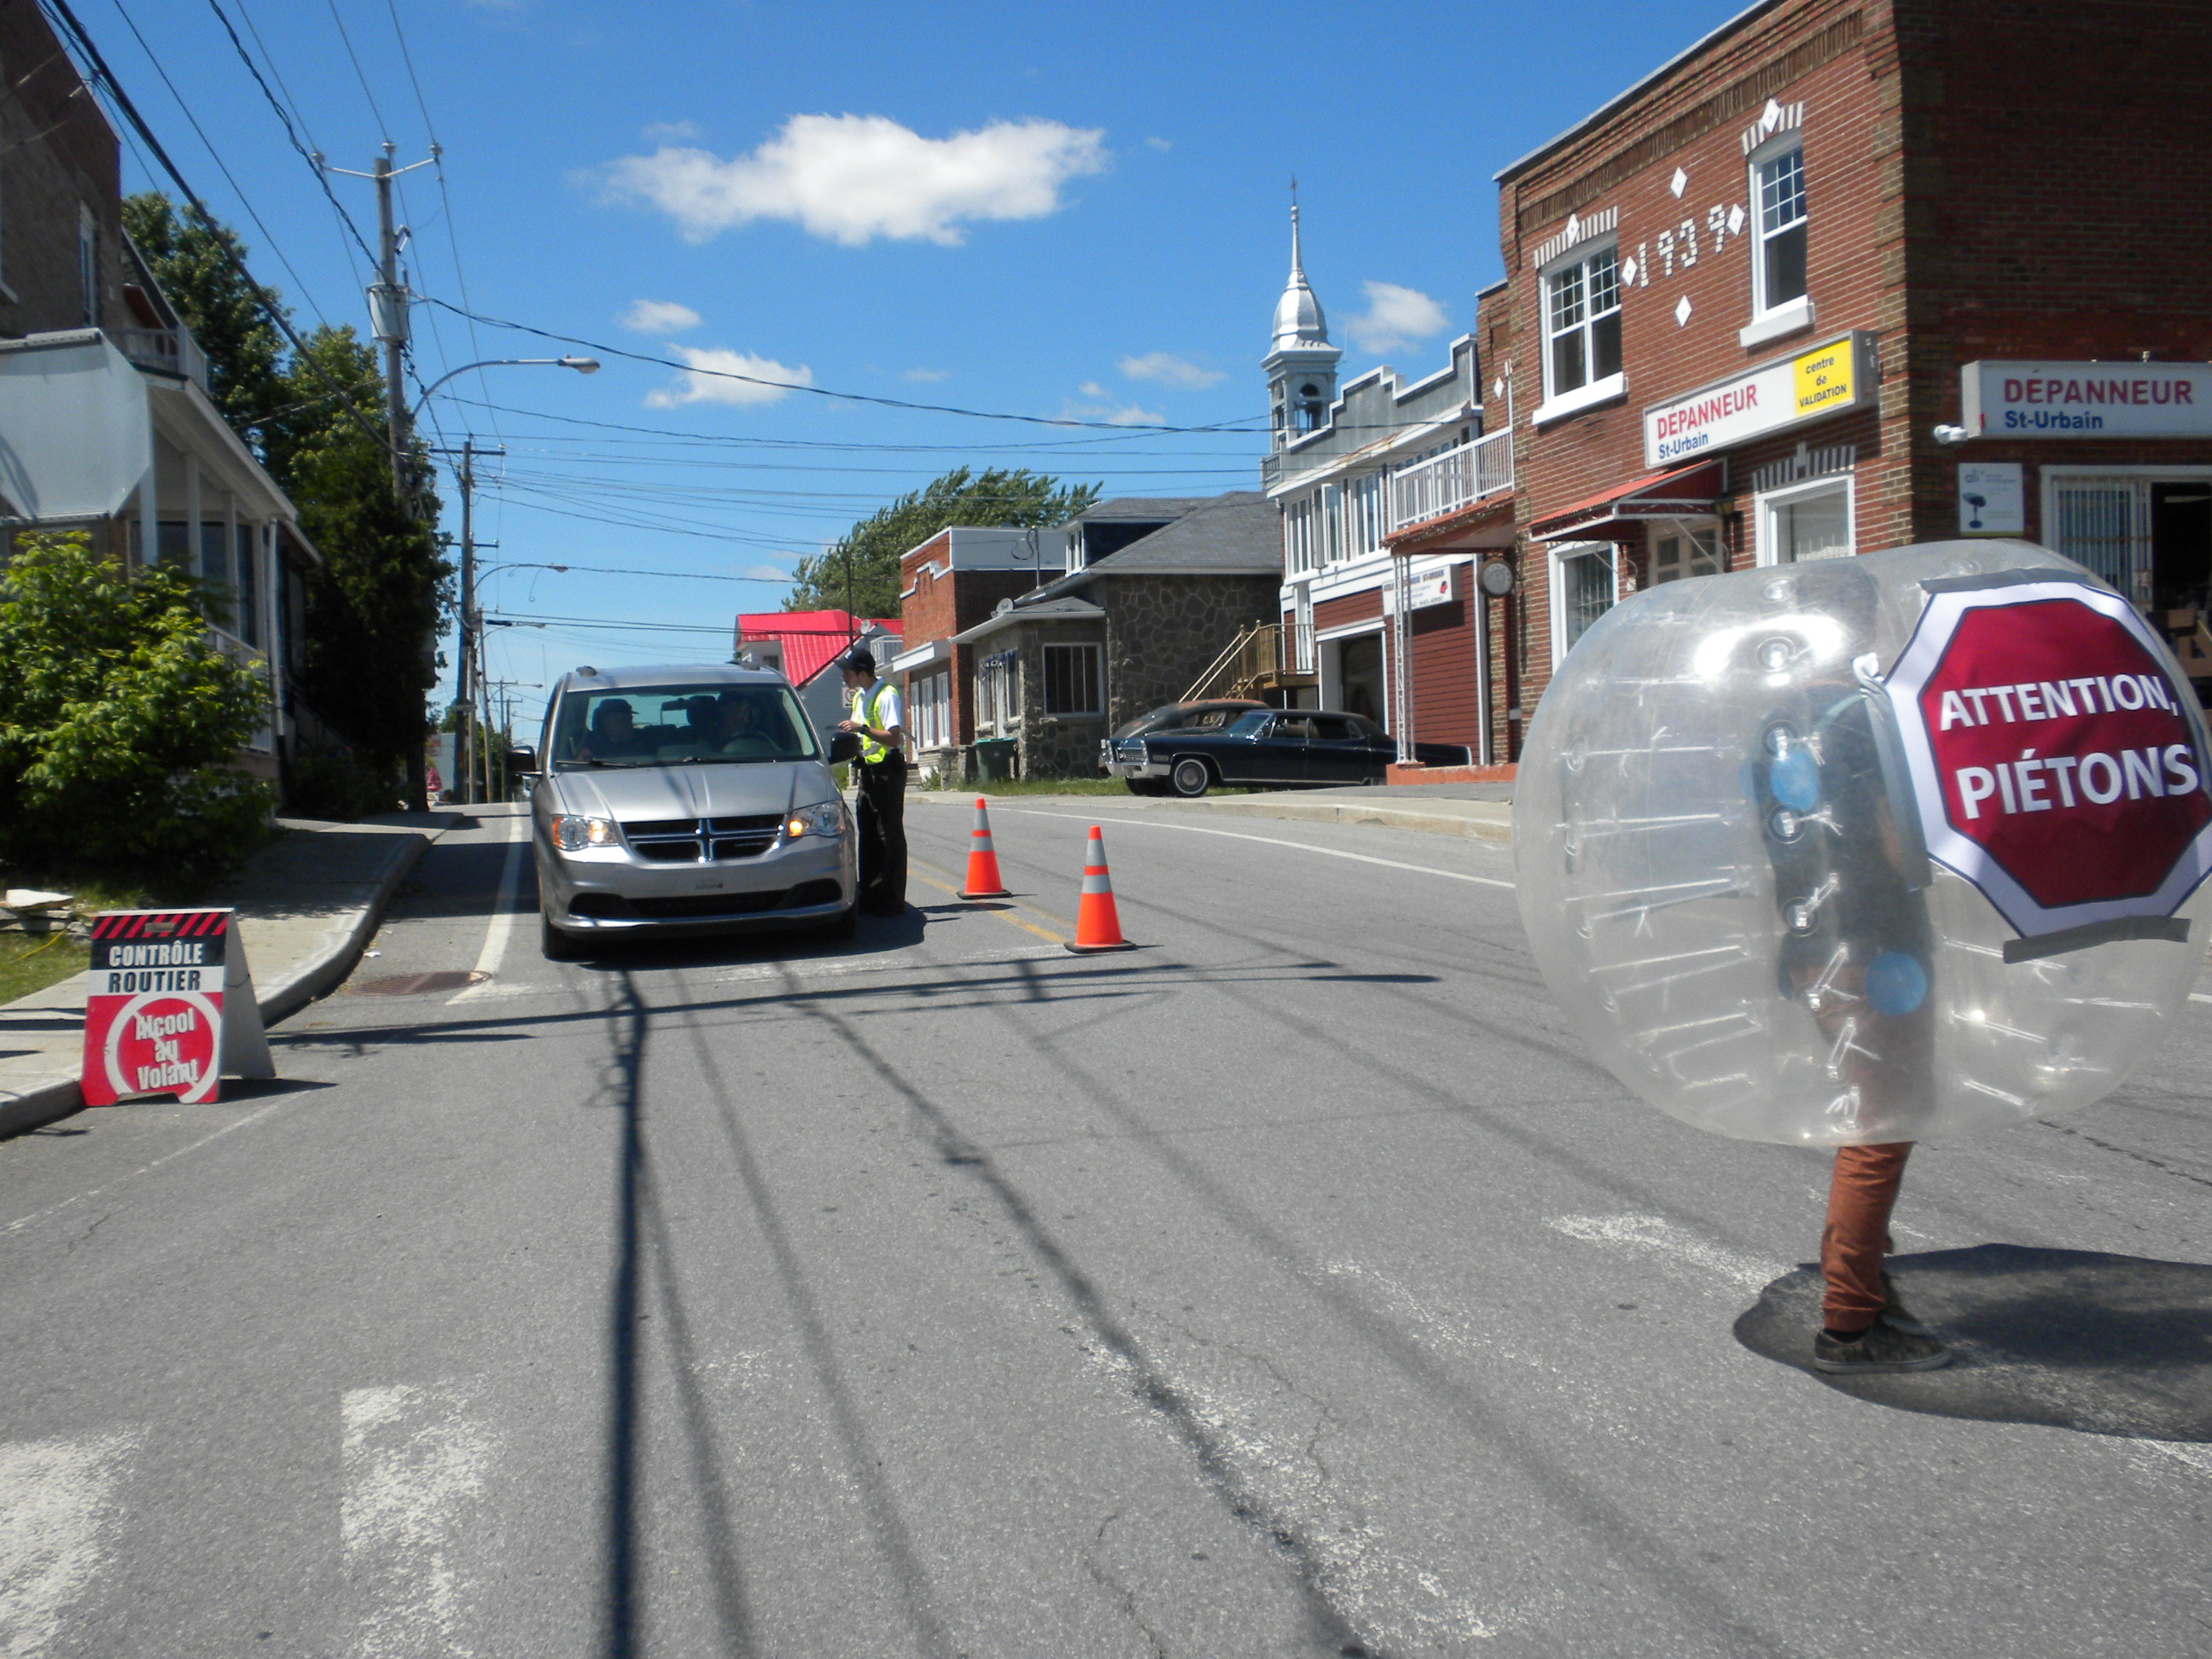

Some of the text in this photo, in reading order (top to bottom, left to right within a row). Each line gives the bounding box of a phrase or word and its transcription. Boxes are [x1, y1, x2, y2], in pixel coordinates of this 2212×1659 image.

[1638, 203, 1726, 288] 1939
[1805, 356, 1835, 375] centre
[1816, 375, 1827, 386] de
[2004, 370, 2194, 405] DÉPANNEUR
[1799, 384, 1848, 408] VALIDATION
[1656, 384, 1758, 440] DÉPANNEUR
[2005, 410, 2104, 429] St-Urbain
[1658, 432, 1709, 460] St-Urbain
[1940, 673, 2180, 732] ATTENTION,
[1956, 743, 2199, 820] PIÉTONS
[108, 940, 203, 968] CONTRÔLE
[108, 969, 201, 993] ROUTIER
[135, 1007, 195, 1040] Alcool
[154, 1039, 178, 1063] au
[137, 1058, 199, 1091] Volant
